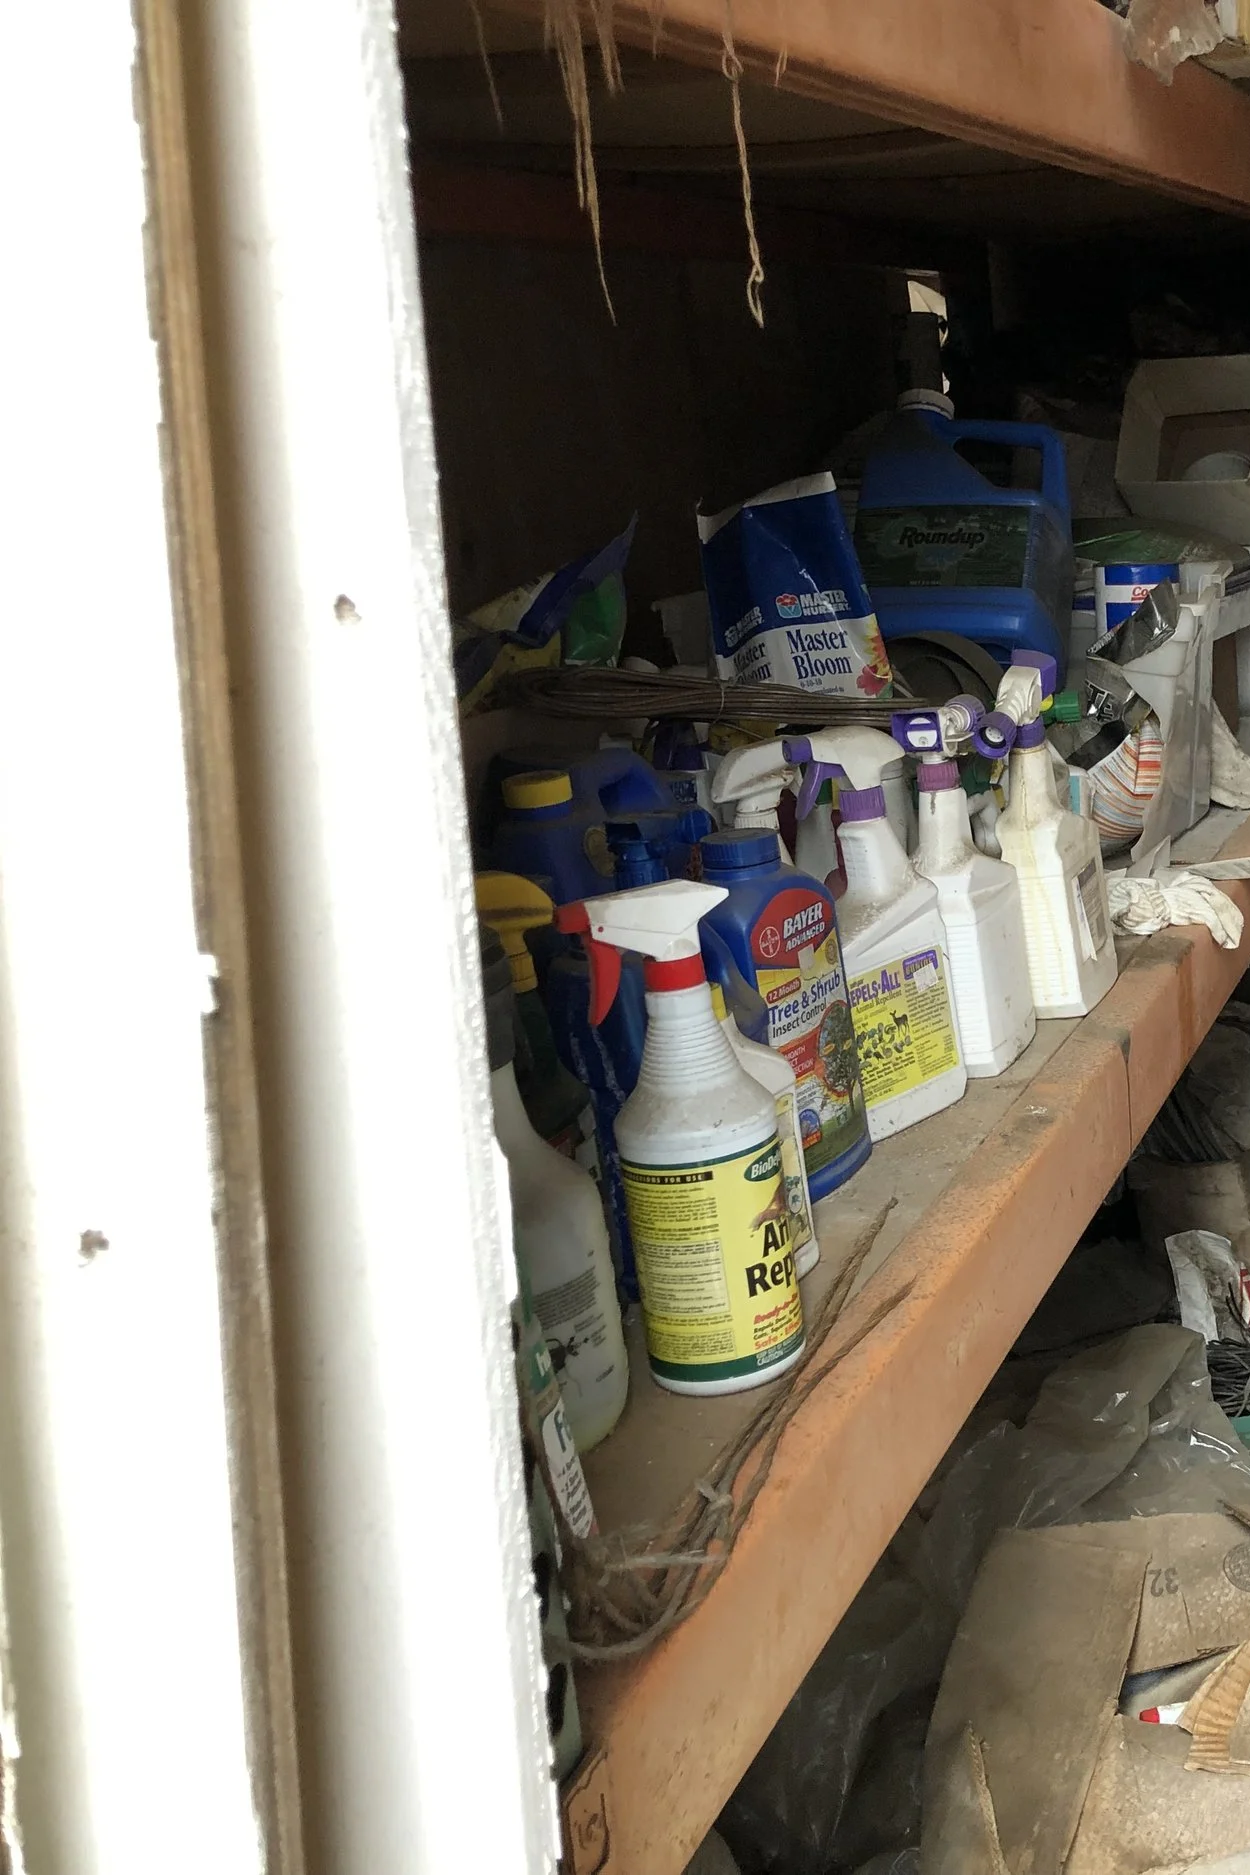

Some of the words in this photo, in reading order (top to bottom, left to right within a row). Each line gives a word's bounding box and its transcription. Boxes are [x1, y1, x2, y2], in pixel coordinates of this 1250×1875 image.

[898, 526, 985, 548] Roundup
[800, 590, 847, 608] MASTER
[786, 628, 849, 655] Master
[792, 655, 853, 680] Bloom
[783, 902, 823, 939] BAYER
[785, 922, 825, 952] ADVANCED
[769, 997, 801, 1026] Tree
[801, 990, 811, 1009] &
[811, 970, 841, 1004] Shrub
[772, 1020, 801, 1039] Insect
[801, 998, 827, 1024] Control
[664, 1174, 681, 1183] FOR
[685, 1173, 703, 1182] USE
[754, 1335, 779, 1350] Safe
